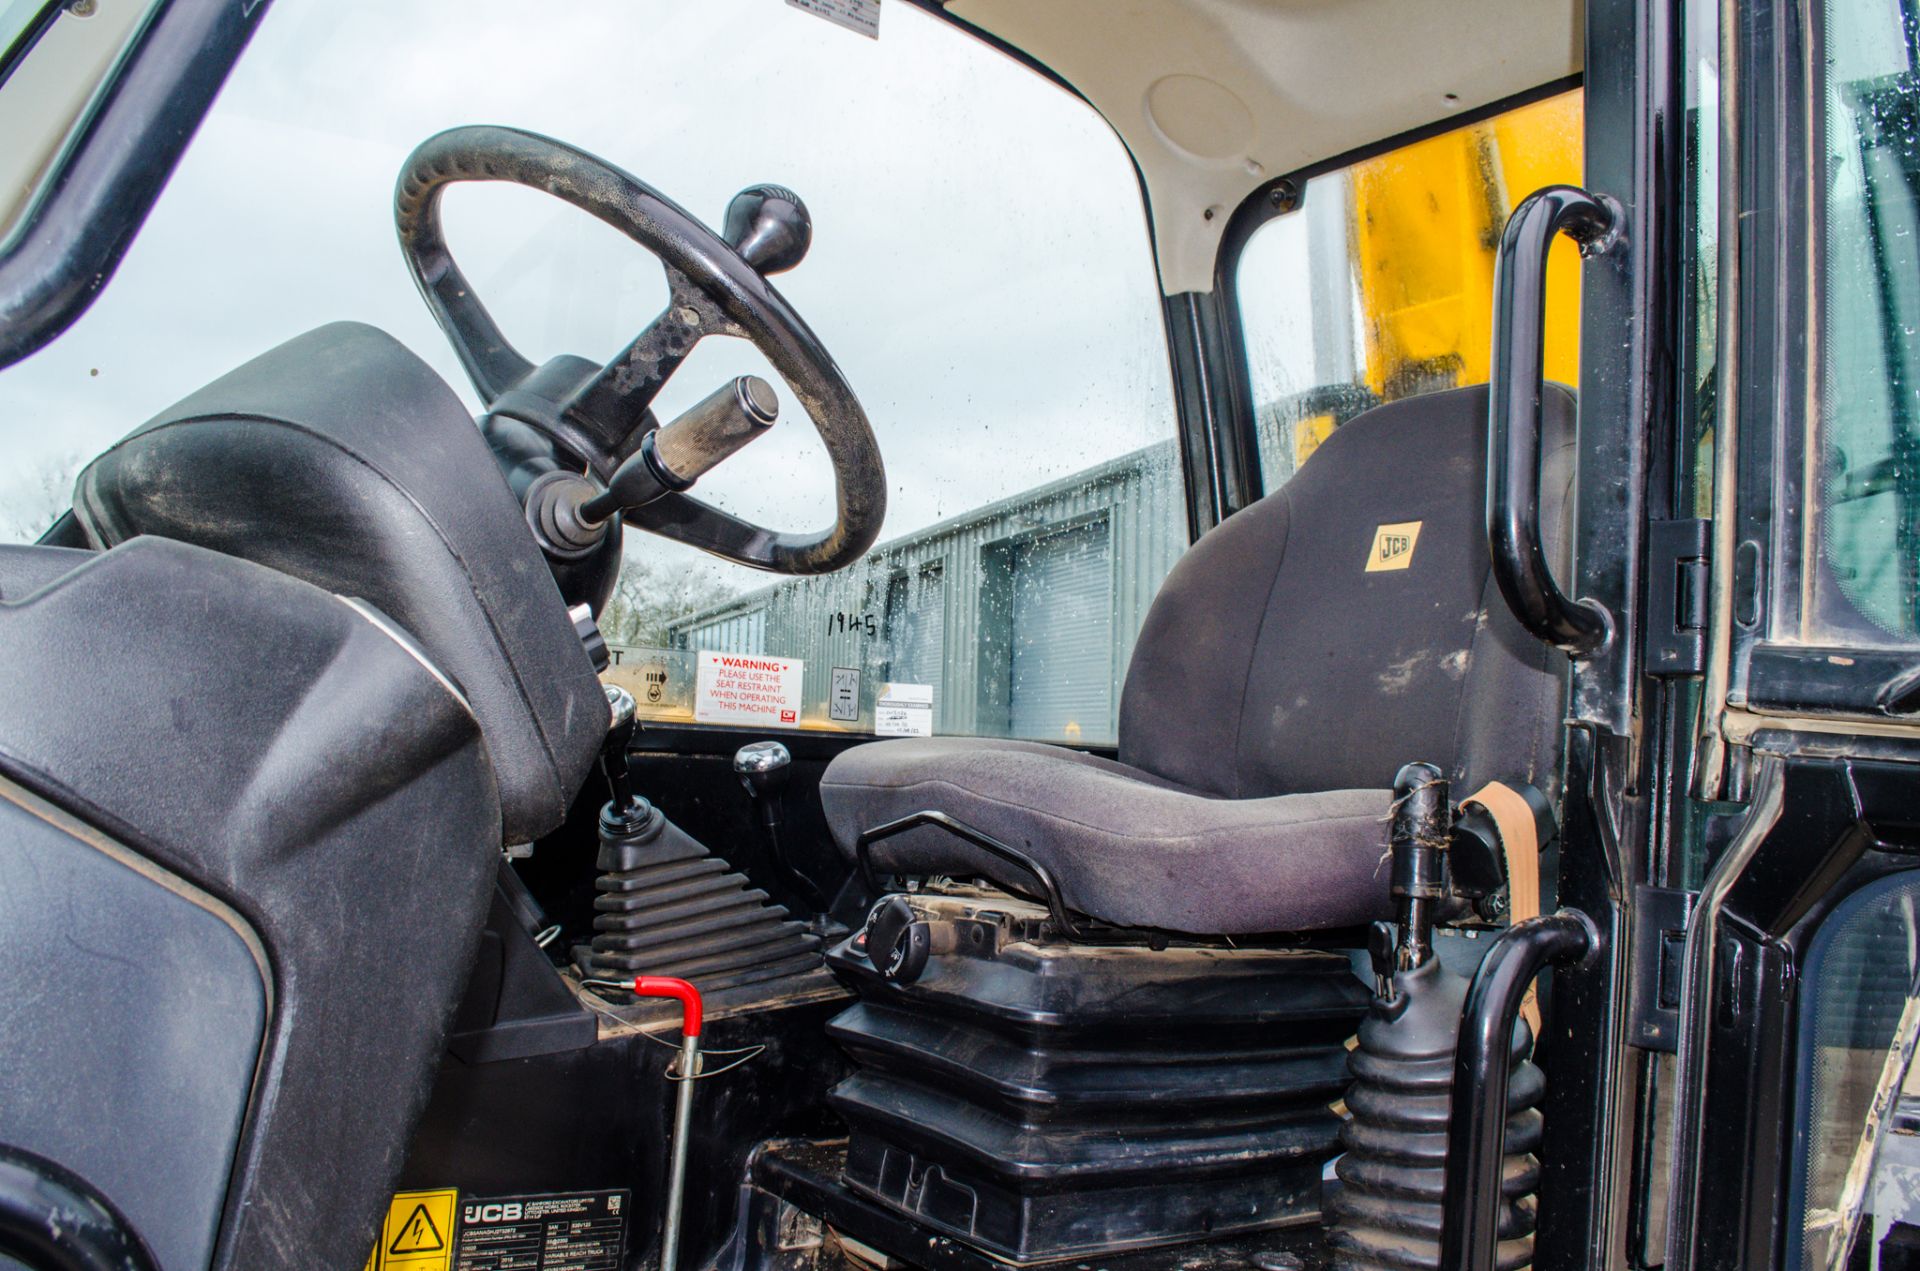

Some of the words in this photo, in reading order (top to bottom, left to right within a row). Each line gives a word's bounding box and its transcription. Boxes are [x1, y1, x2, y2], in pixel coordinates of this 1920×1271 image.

[1382, 536, 1408, 559] JCB
[828, 611, 876, 636] 1945
[722, 656, 779, 672] WARNING
[719, 668, 747, 679] PLEASE
[749, 672, 765, 681] USE
[766, 673, 781, 683] THE
[716, 679, 735, 688] SEAT
[737, 681, 782, 693] RESTRAINT
[710, 689, 737, 699] WHEN
[739, 692, 786, 704] OPERATING
[718, 701, 736, 710] THIS
[739, 703, 776, 714] MACHINE
[464, 1203, 522, 1224] JCB
